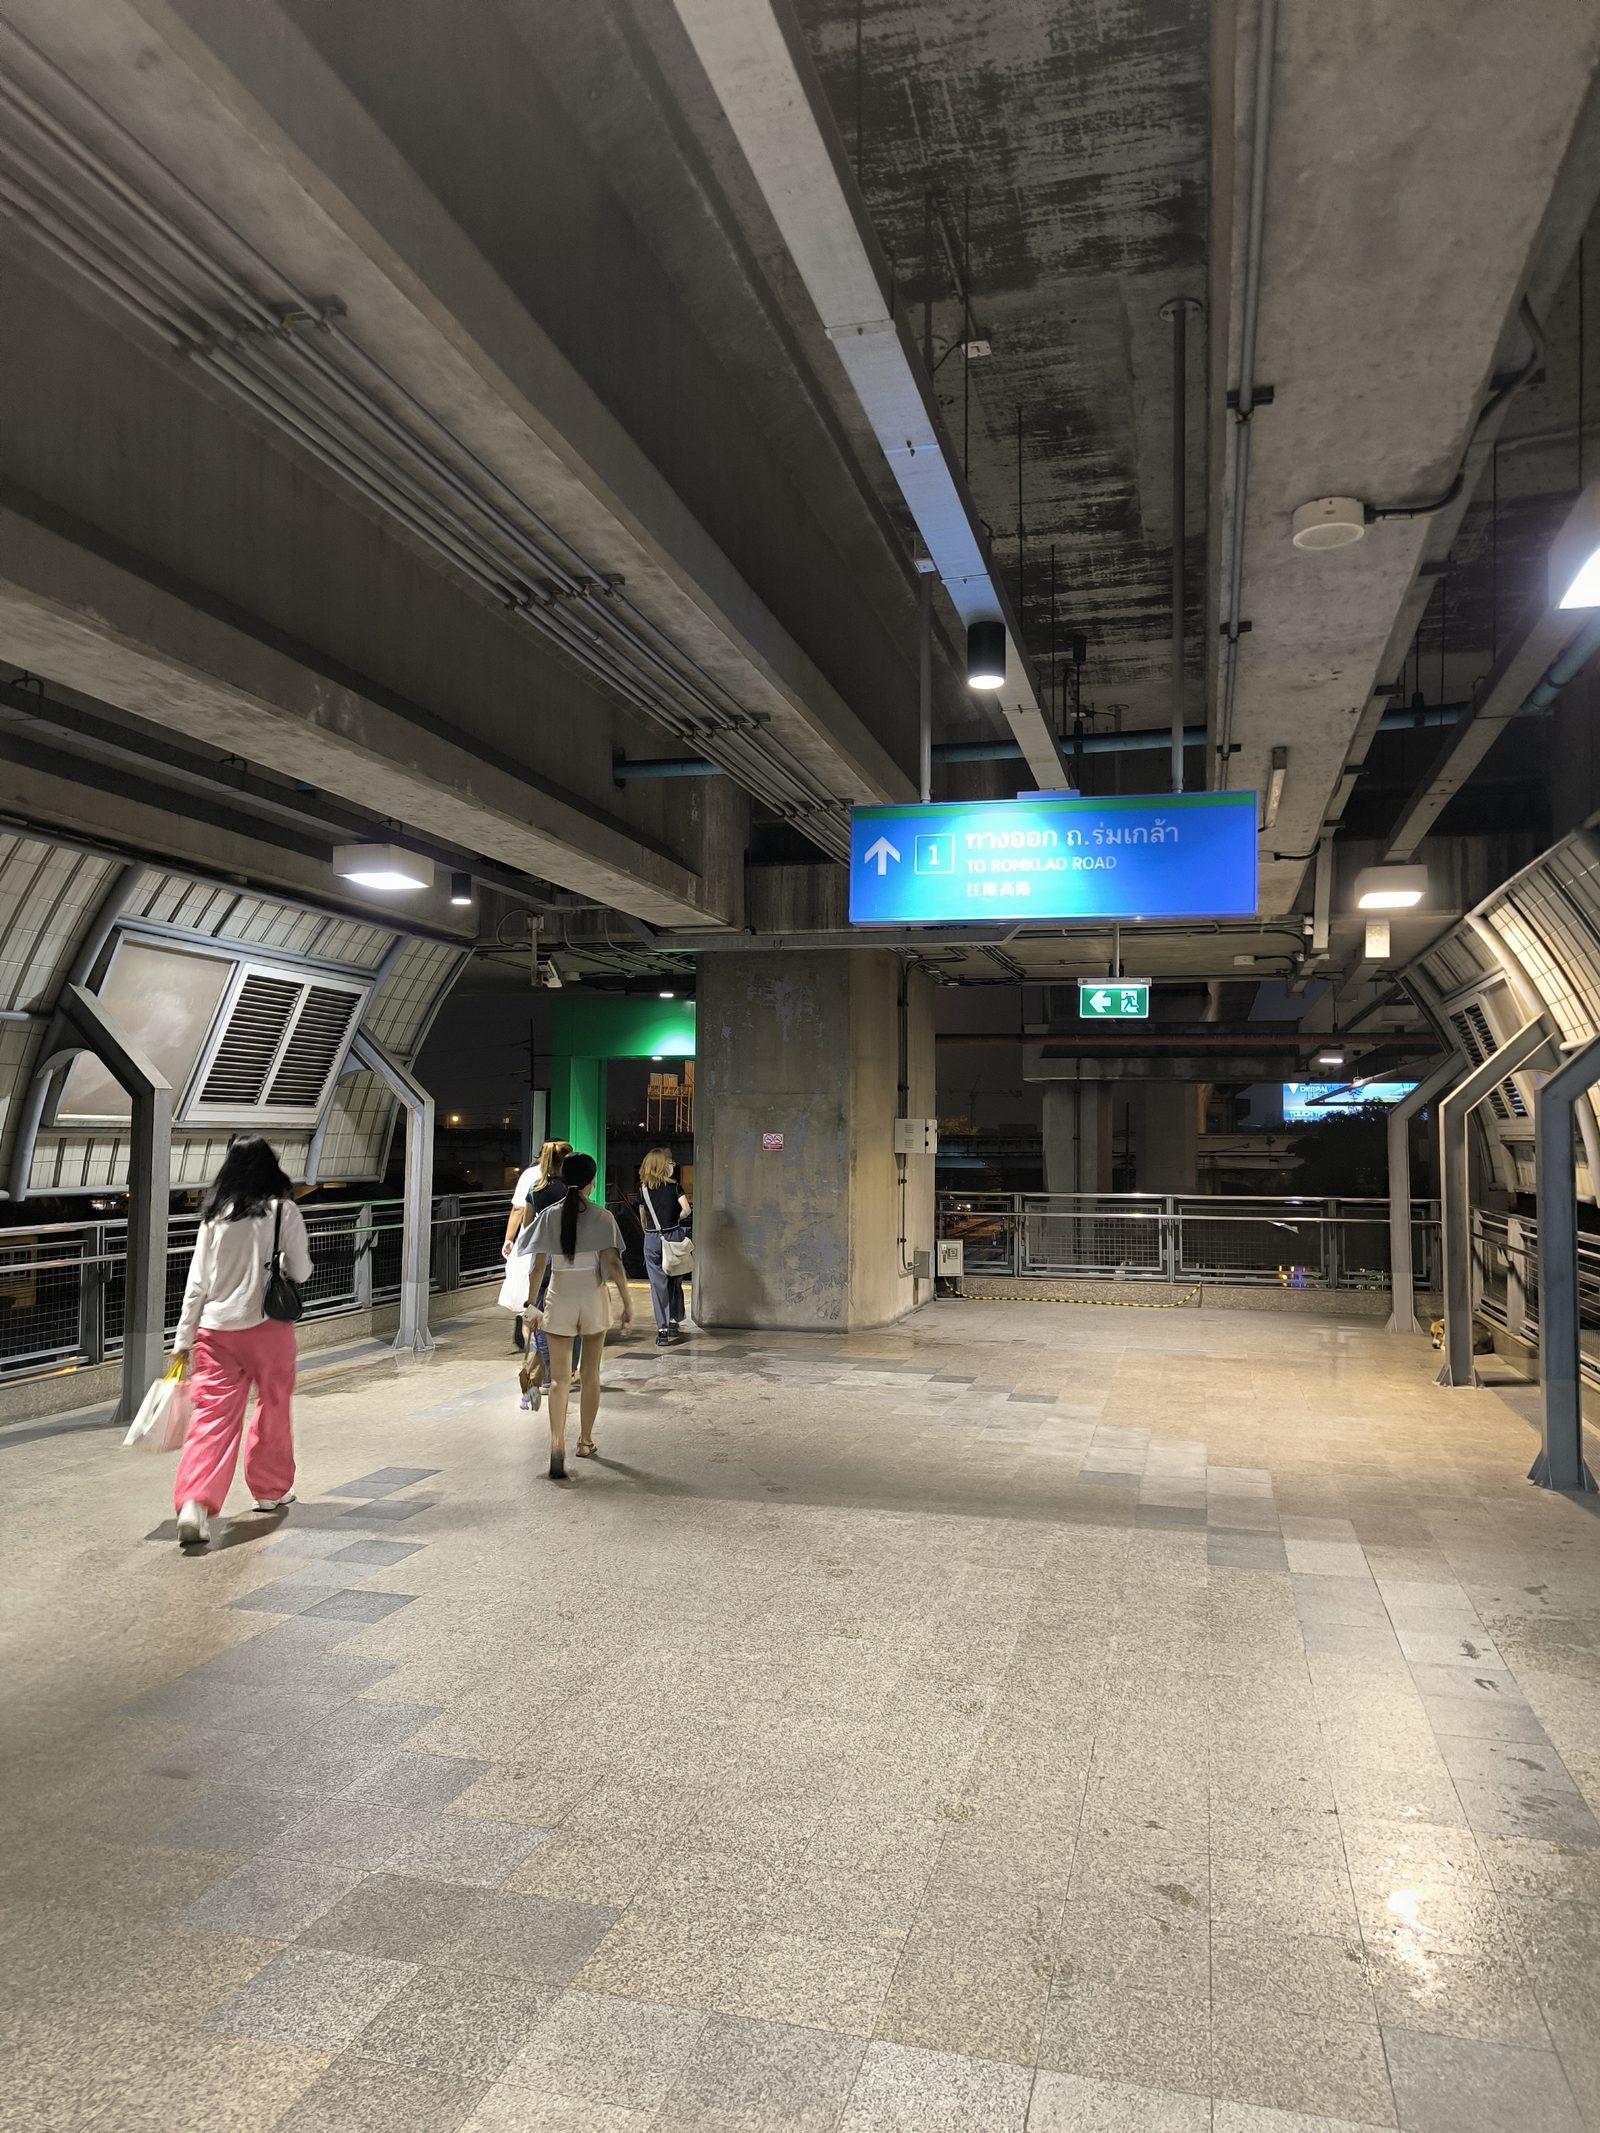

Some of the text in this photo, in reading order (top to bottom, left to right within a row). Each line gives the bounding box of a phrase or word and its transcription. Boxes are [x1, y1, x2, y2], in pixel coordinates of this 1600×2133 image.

[965, 830, 1058, 849] ทางออก
[928, 843, 940, 865] 1
[966, 855, 1117, 873] TO ROMKLAO ROAD
